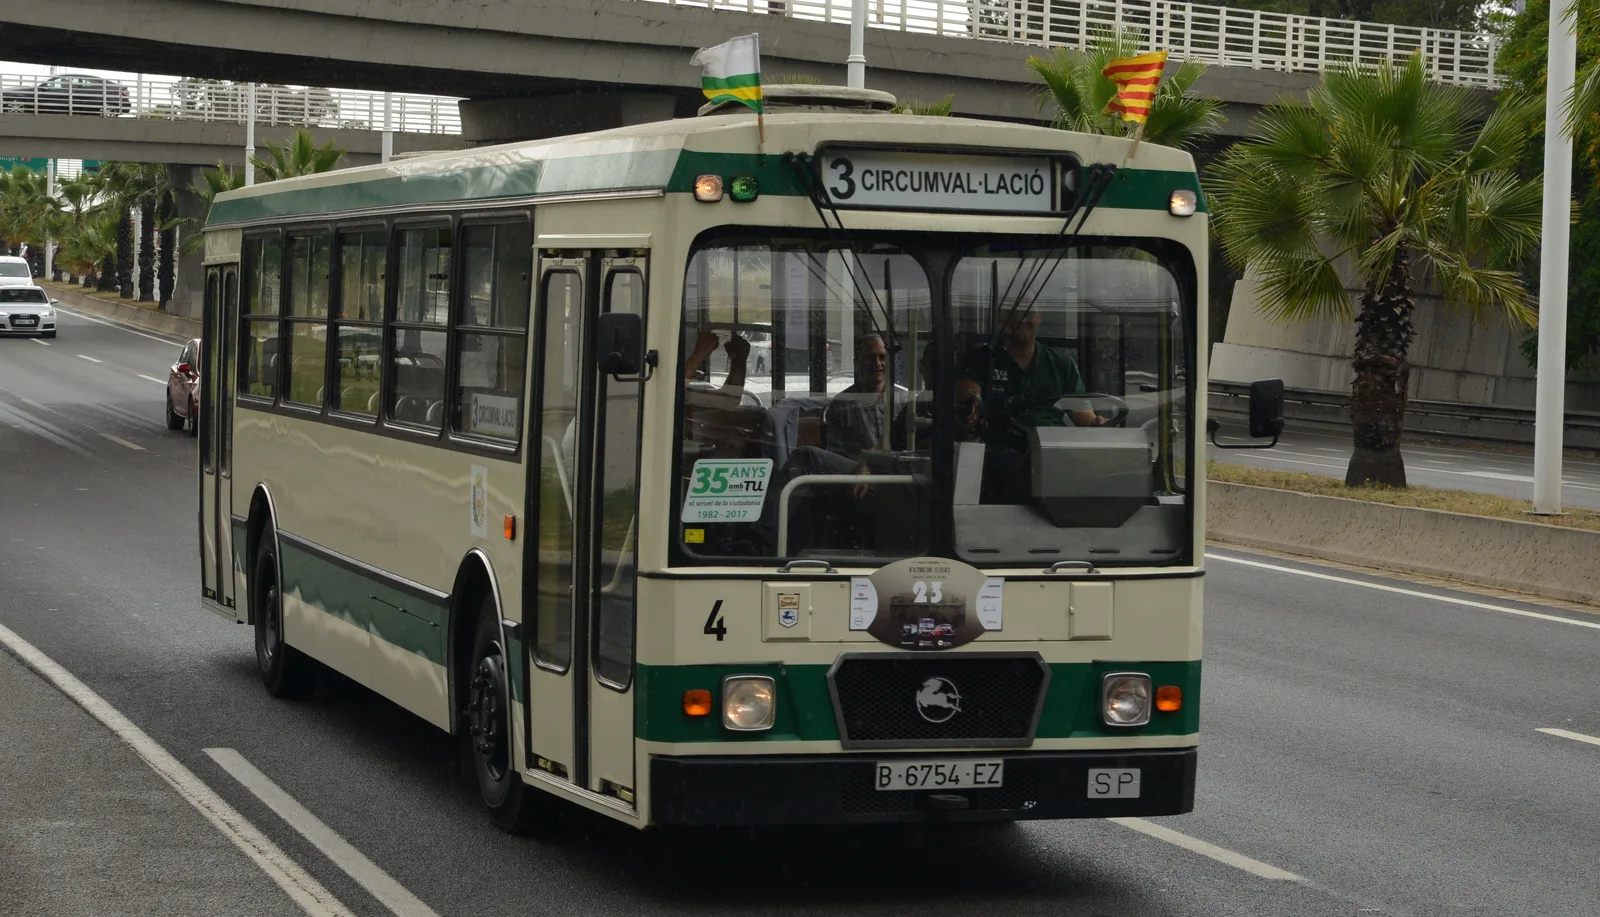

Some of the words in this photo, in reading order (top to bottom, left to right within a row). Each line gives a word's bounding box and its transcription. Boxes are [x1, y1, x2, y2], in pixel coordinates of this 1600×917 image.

[829, 157, 857, 200] 3
[472, 397, 478, 428] 3
[691, 467, 729, 493] 35
[730, 467, 766, 478] ANYS
[729, 482, 743, 490] amb
[697, 510, 719, 518] 1982
[725, 510, 748, 518] 2017
[912, 580, 942, 603] 23
[703, 600, 727, 641] 4
